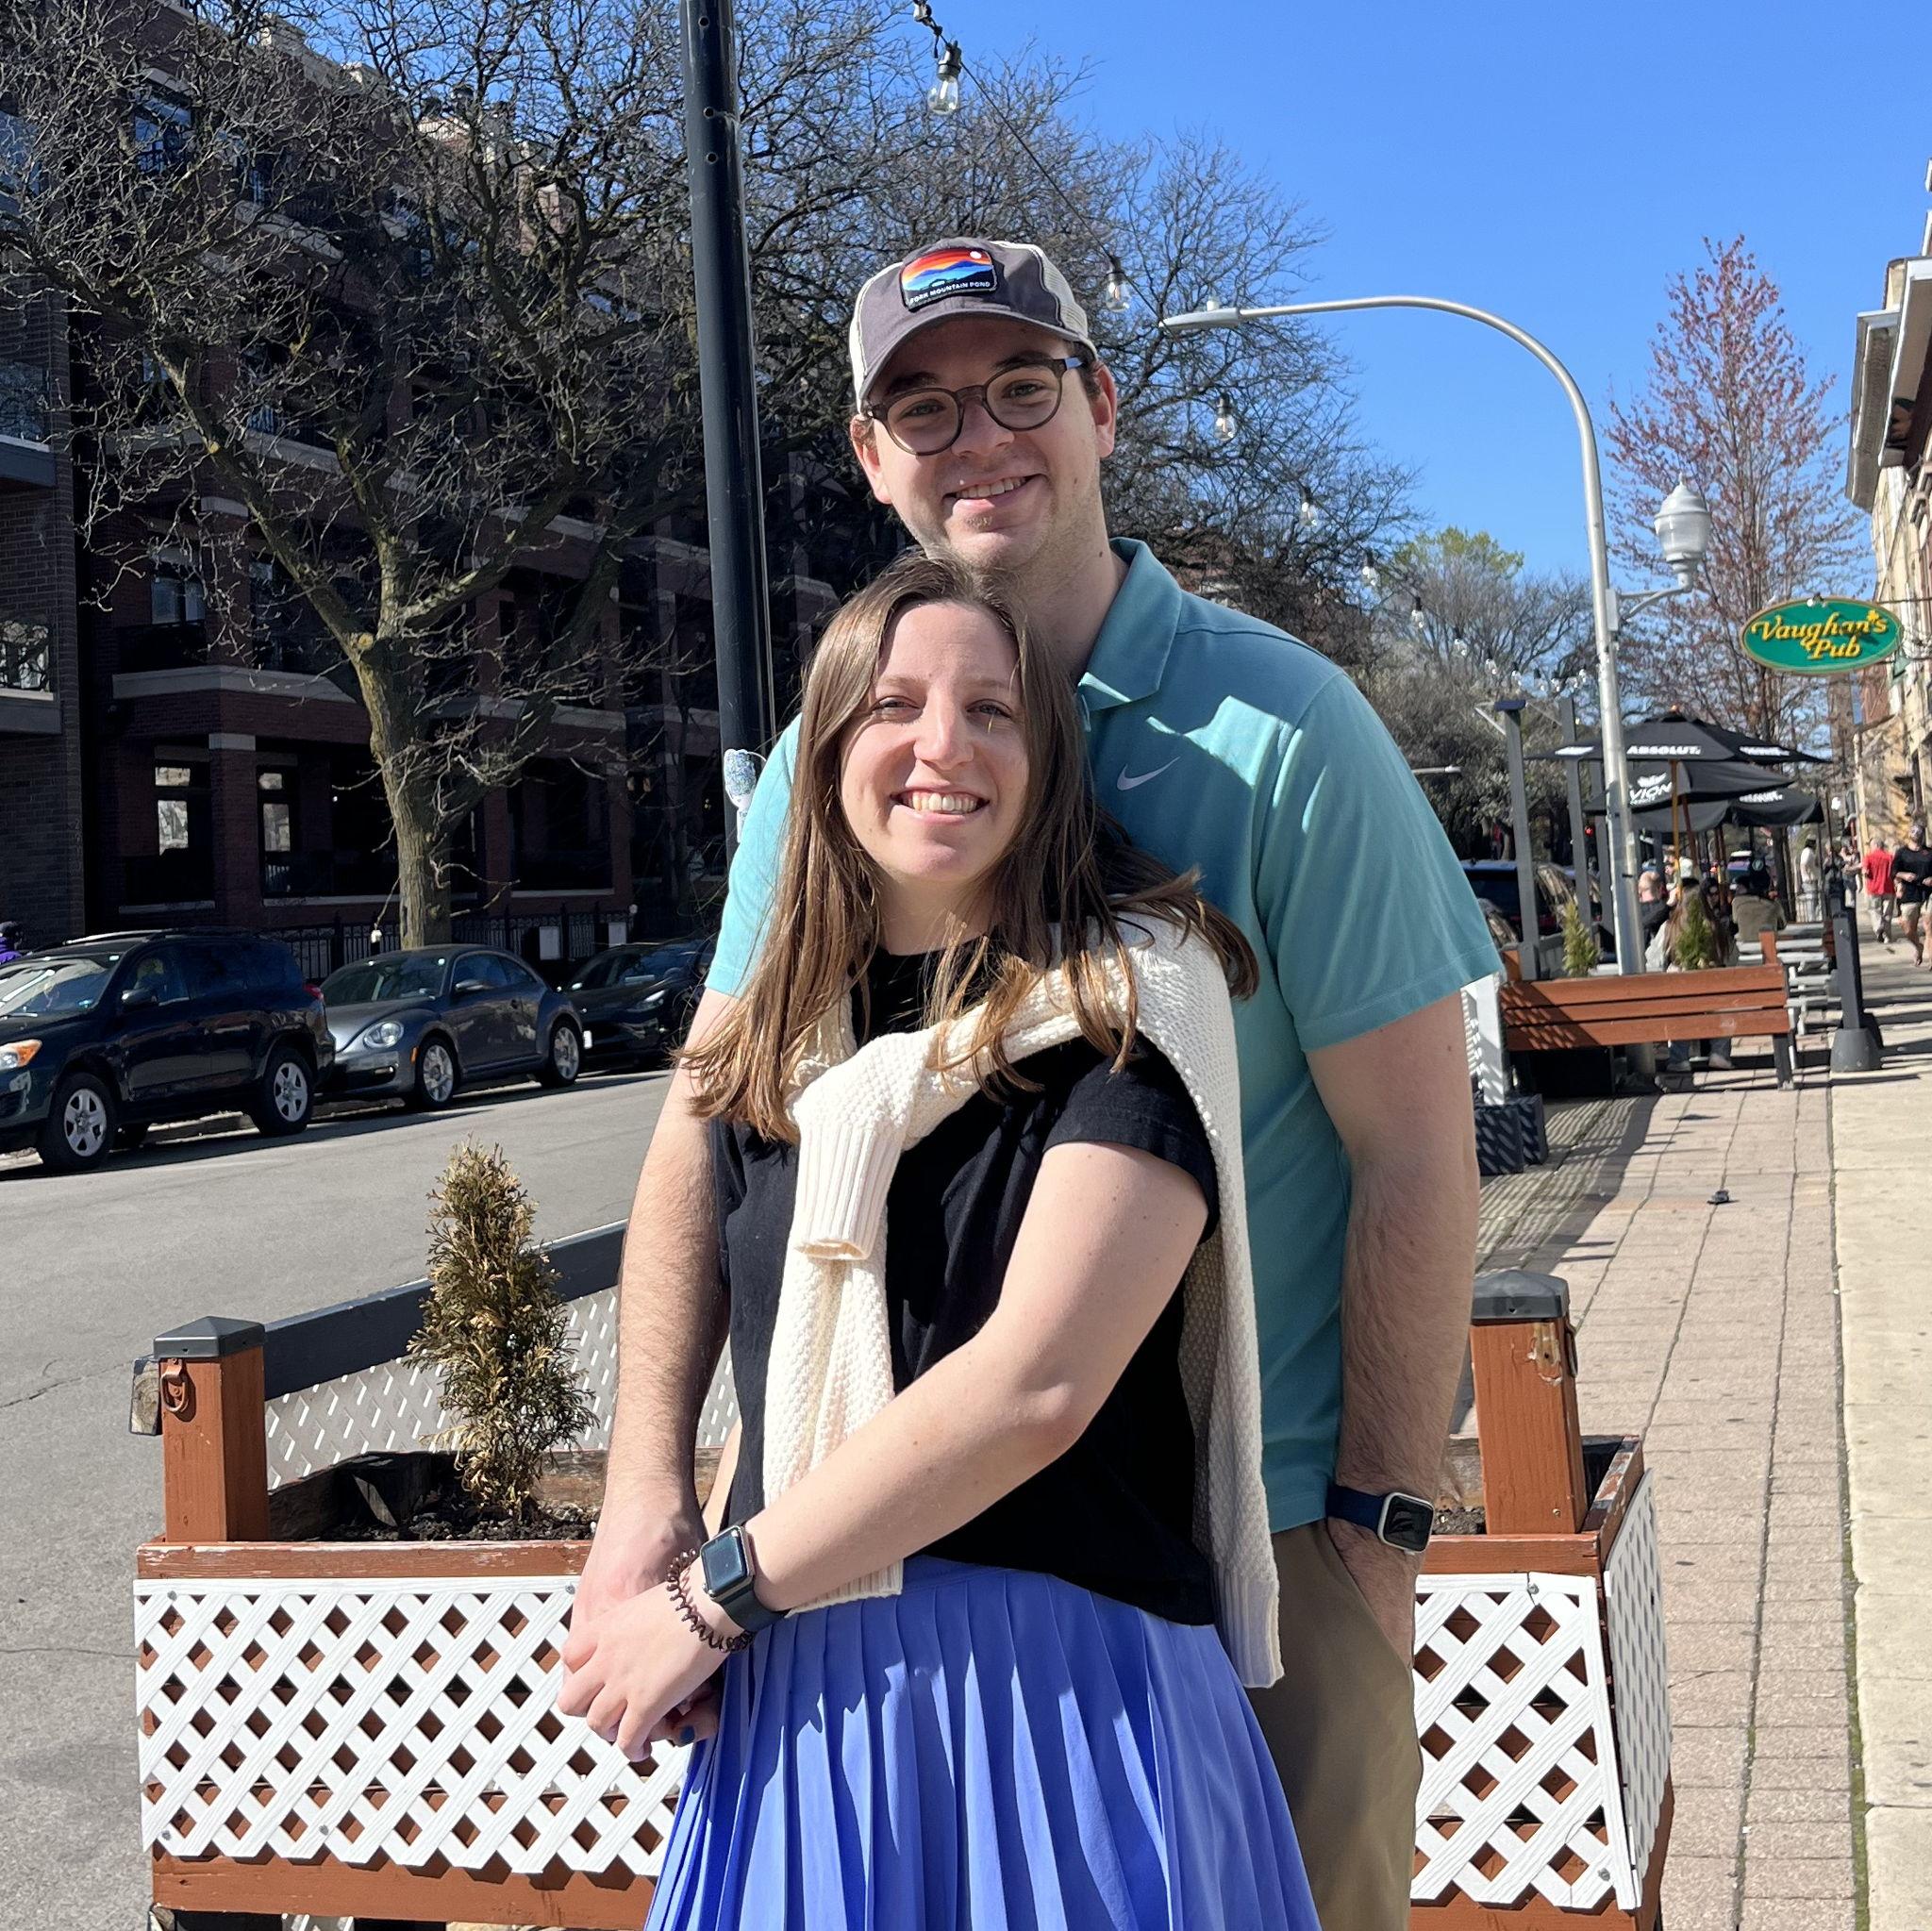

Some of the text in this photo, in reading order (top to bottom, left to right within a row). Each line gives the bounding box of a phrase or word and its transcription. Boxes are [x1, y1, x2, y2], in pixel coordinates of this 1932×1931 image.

[929, 282, 968, 295] MOUNTAIN
[1751, 610, 1888, 649] Vaughan's
[1807, 635, 1861, 659] Pub
